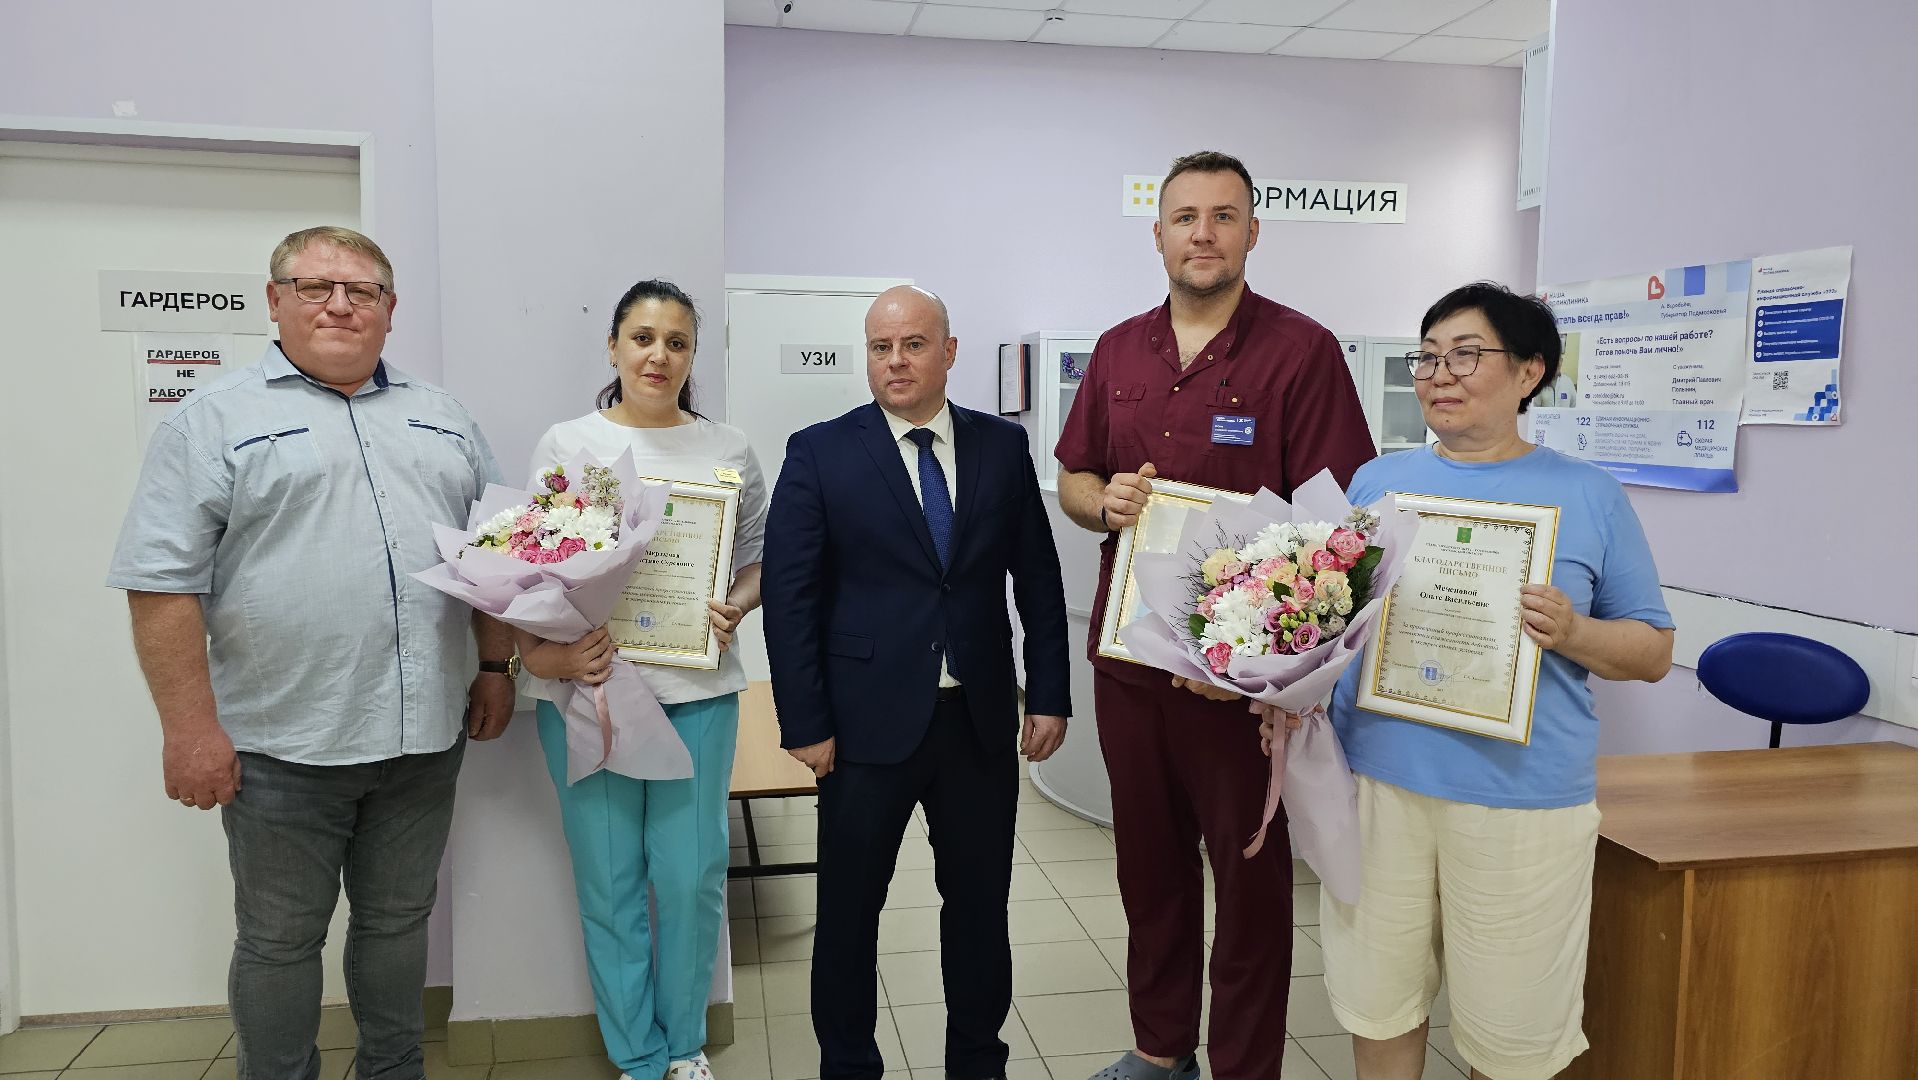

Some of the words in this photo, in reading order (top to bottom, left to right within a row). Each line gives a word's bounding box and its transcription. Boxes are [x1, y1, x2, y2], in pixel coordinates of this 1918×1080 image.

[120, 290, 246, 312] ГАРДЕРОБ
[1577, 313, 1604, 324] всегда
[1654, 331, 1678, 341] нашей
[1679, 329, 1714, 341] работе?
[147, 349, 220, 360] ГАРДЕРОБ
[1595, 348, 1614, 356] Готов
[1639, 346, 1653, 354] Вам
[800, 351, 836, 366] УЗИ
[176, 369, 195, 378] НЕ
[1576, 416, 1591, 426] 122
[1696, 419, 1715, 430] 112
[1414, 554, 1508, 576] БЛАГОДАРСТВЕННОЕ
[1439, 566, 1479, 580] ПИСЬМО
[1419, 591, 1443, 601] Ольге
